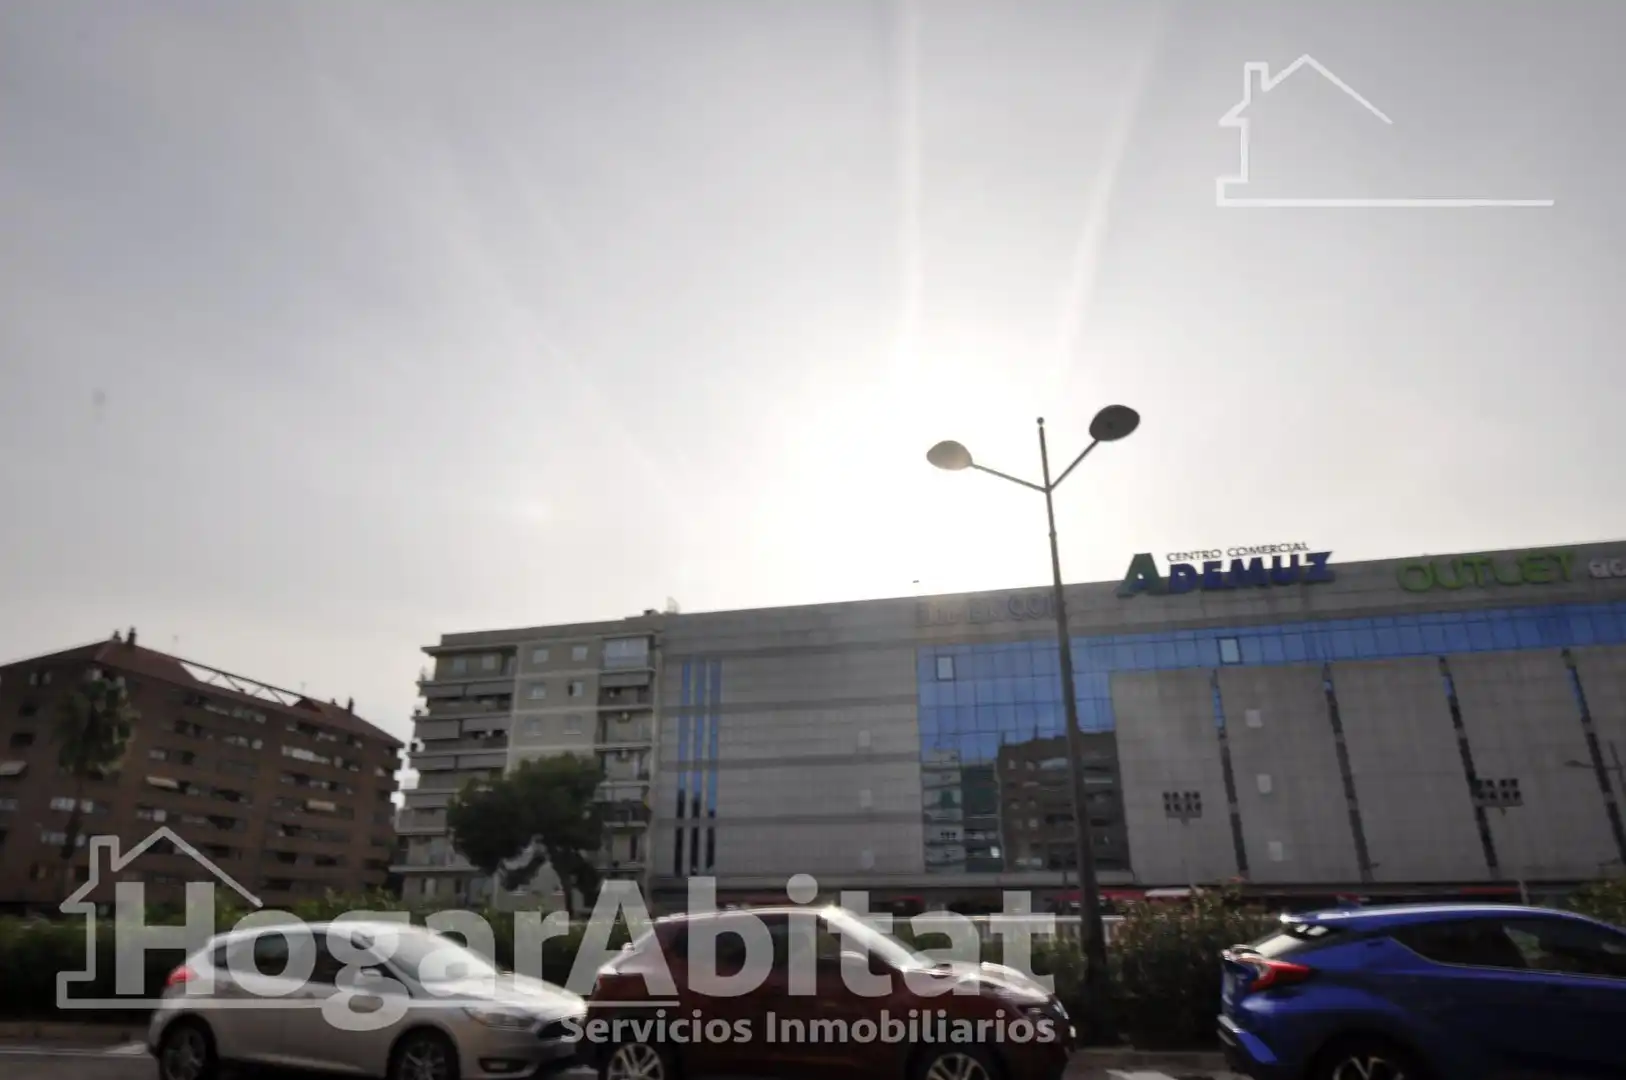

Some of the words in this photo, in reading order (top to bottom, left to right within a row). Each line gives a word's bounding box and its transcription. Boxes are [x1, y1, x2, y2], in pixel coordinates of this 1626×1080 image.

[1166, 548, 1222, 562] CENTRO
[1227, 542, 1309, 557] COMERCIAL
[1397, 550, 1574, 592] OUTLET
[1115, 551, 1333, 598] ADEMUZ
